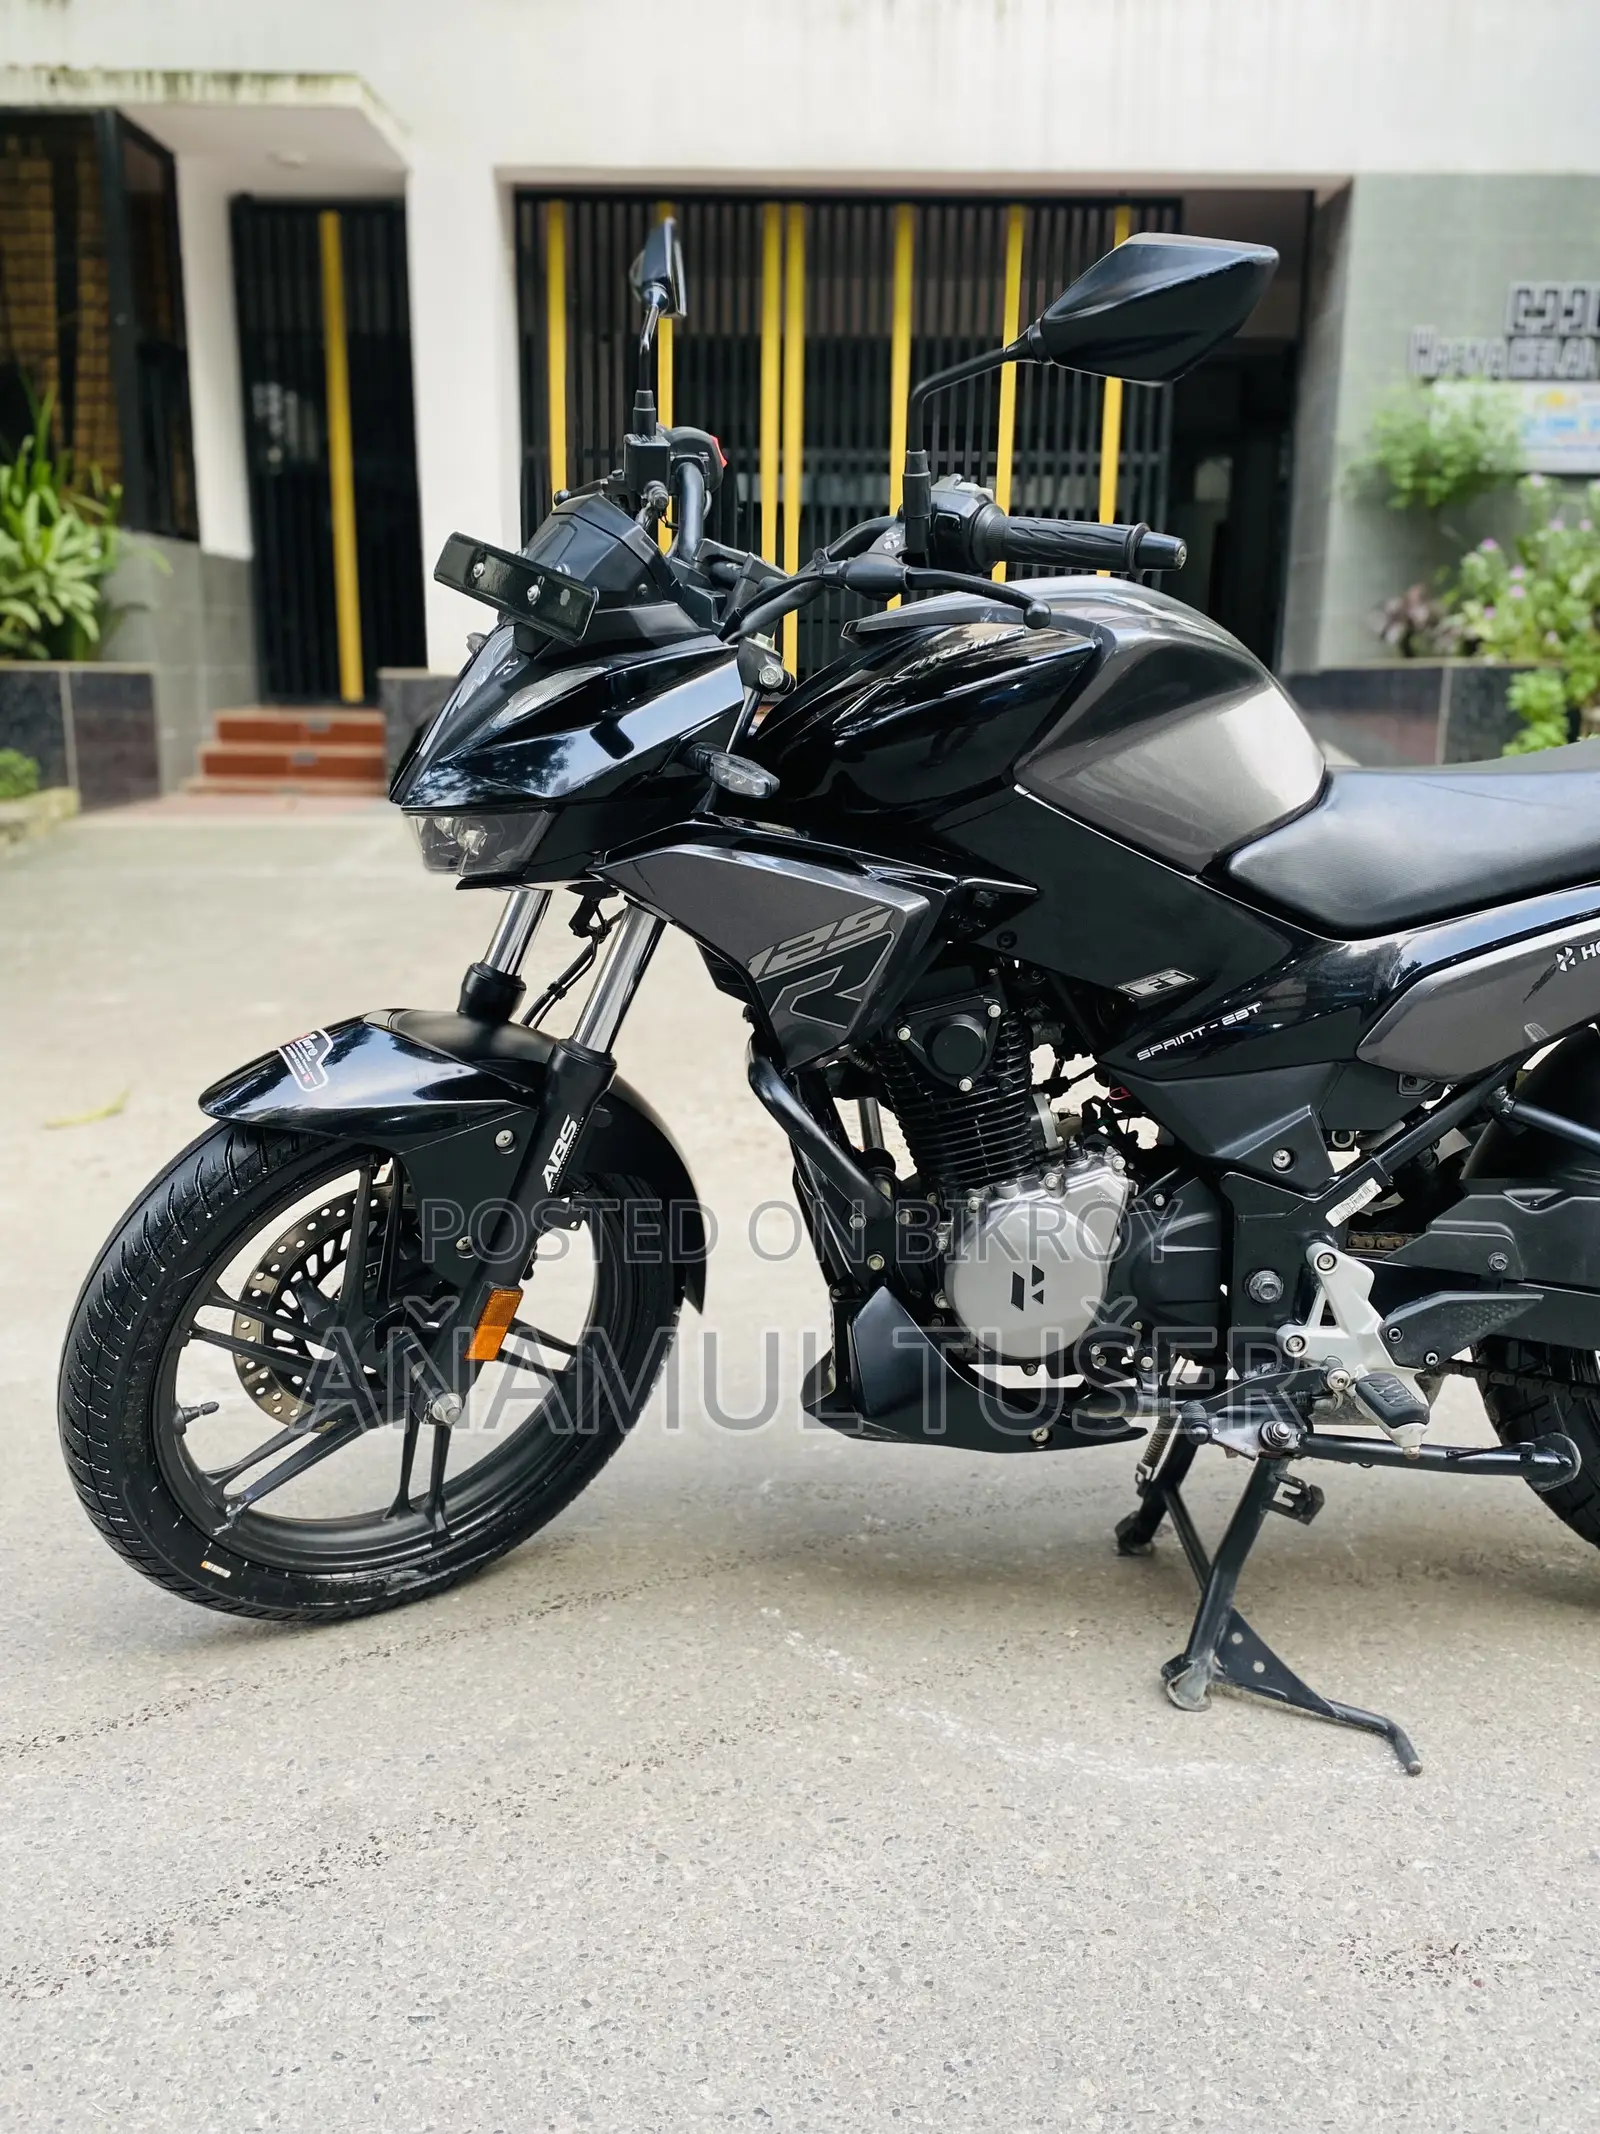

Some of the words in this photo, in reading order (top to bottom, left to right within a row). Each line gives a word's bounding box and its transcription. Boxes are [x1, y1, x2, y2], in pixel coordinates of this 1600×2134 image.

[747, 904, 895, 979] 125
[1137, 1026, 1206, 1061] SPRINT
[541, 1113, 578, 1193] ABS
